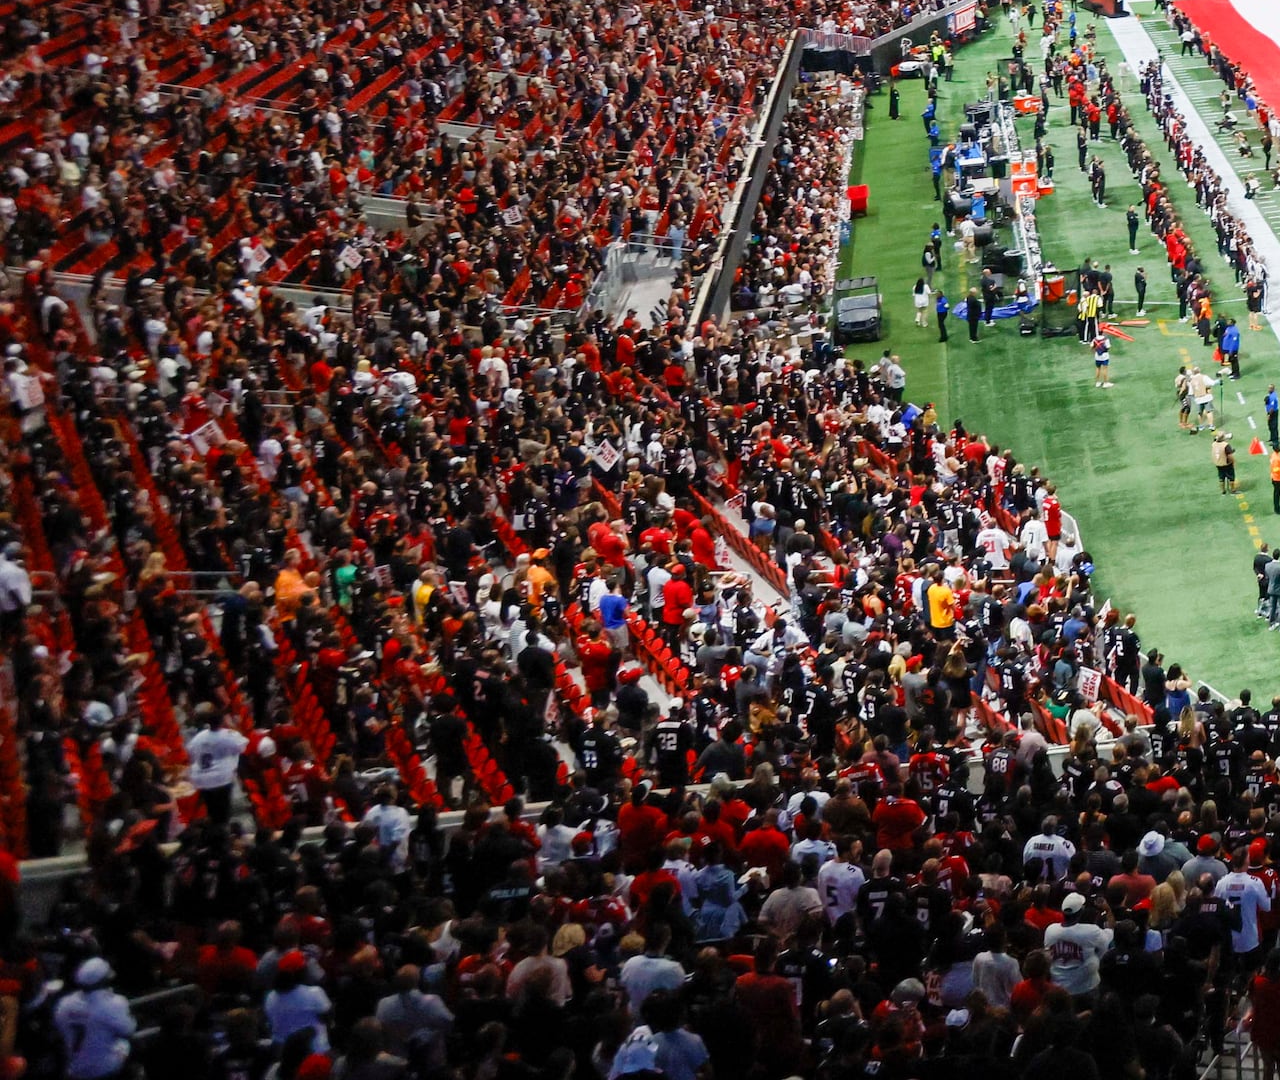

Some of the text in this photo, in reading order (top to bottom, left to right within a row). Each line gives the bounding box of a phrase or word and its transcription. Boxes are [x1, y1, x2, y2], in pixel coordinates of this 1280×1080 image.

[911, 529, 920, 547] 7
[1029, 533, 1035, 544] 7
[984, 542, 997, 553] 21
[1081, 678, 1091, 697] UP
[1089, 673, 1099, 699] RISE
[991, 758, 1007, 773] 88
[871, 901, 884, 921] 7
